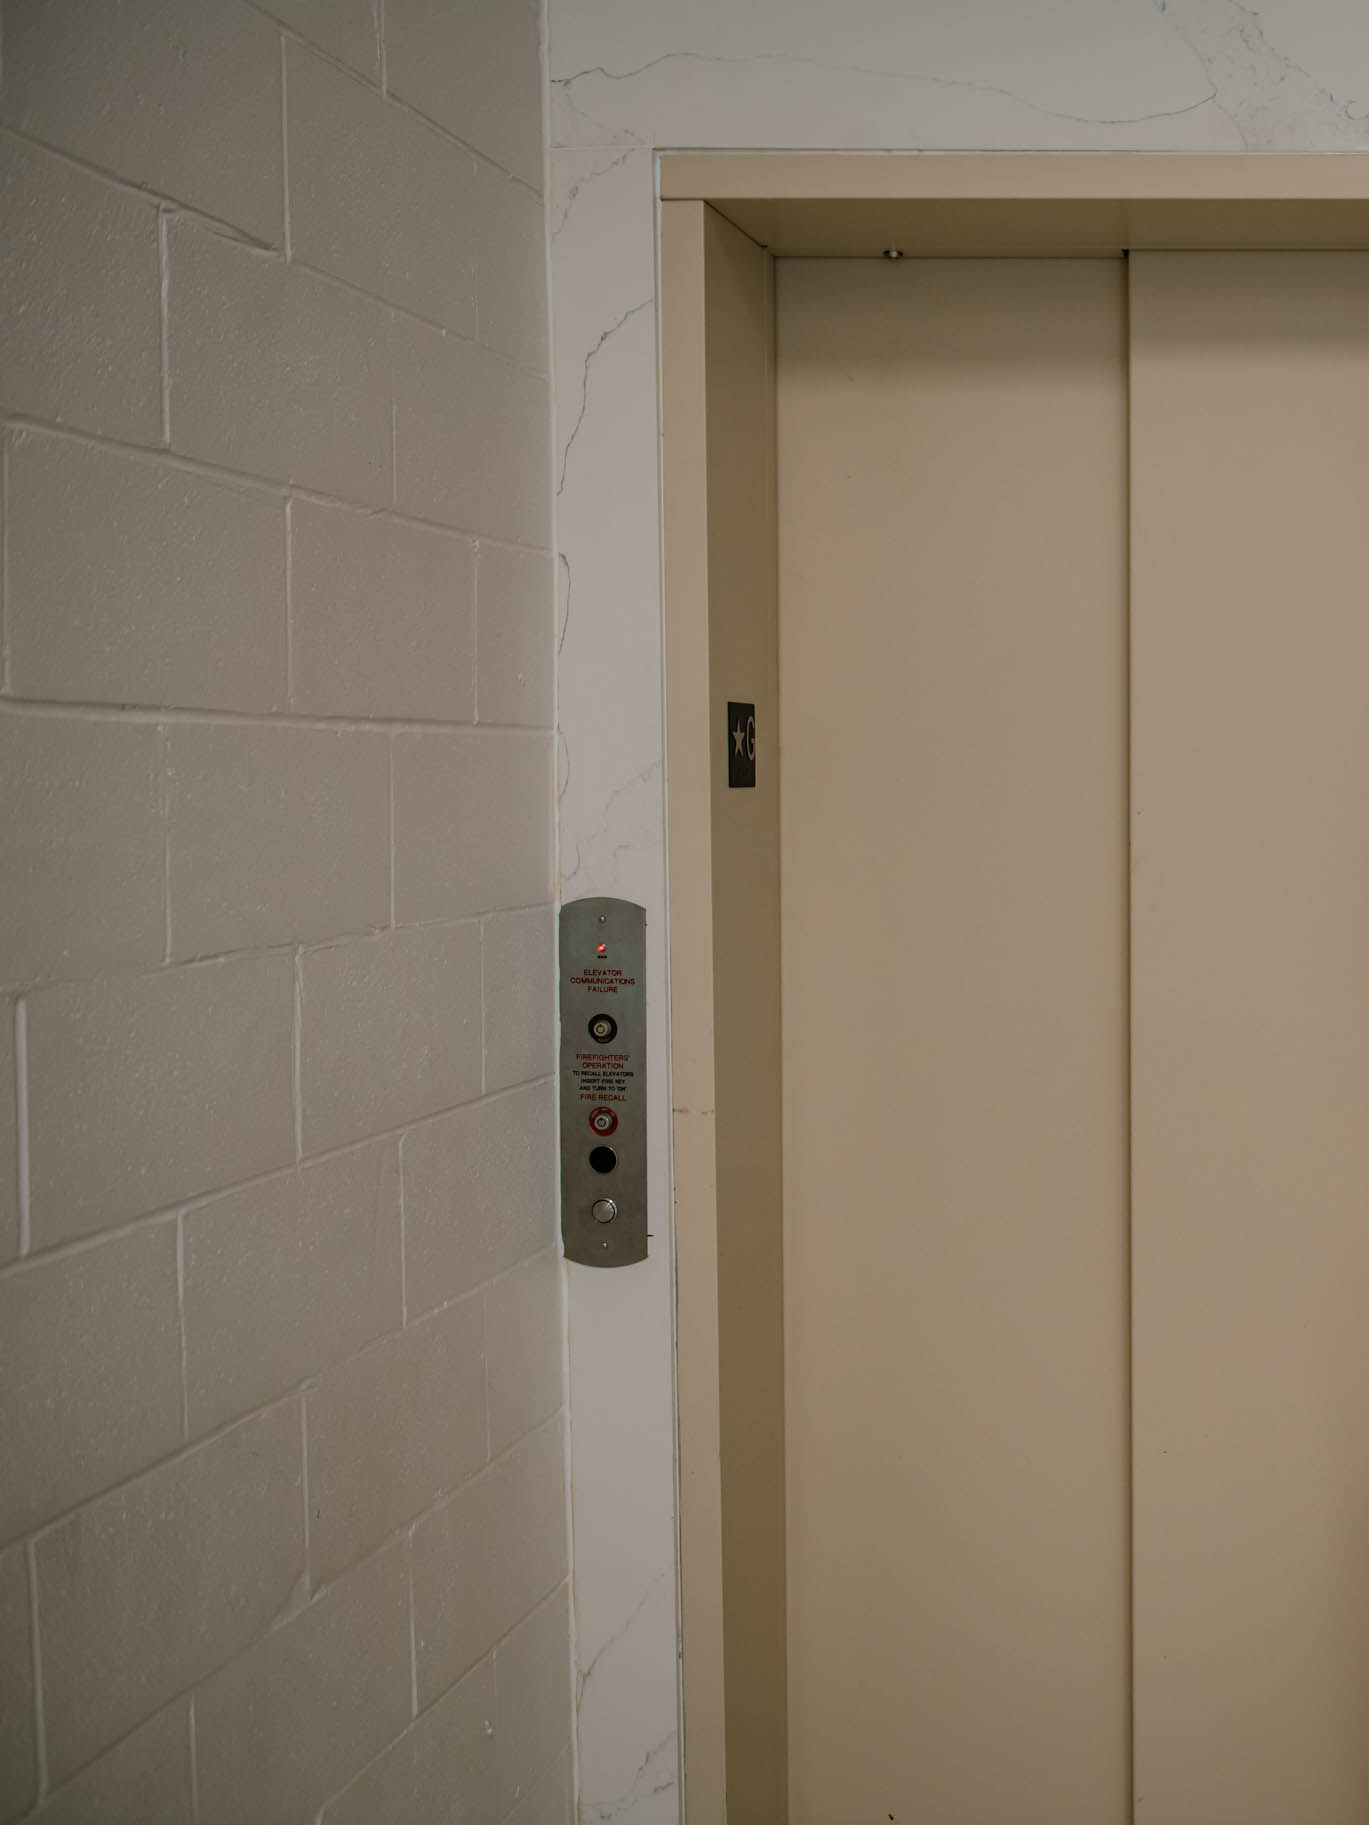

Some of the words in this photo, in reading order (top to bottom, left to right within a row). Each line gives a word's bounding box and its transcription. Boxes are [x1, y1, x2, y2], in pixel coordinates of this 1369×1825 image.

[584, 969, 622, 977] ELEVATOR
[570, 977, 636, 985] COMMUNICATIONS
[587, 985, 618, 993] FAILURE
[582, 1062, 624, 1070] OPERATION
[580, 1093, 597, 1101] FIRE
[598, 1094, 626, 1102] RECALL
